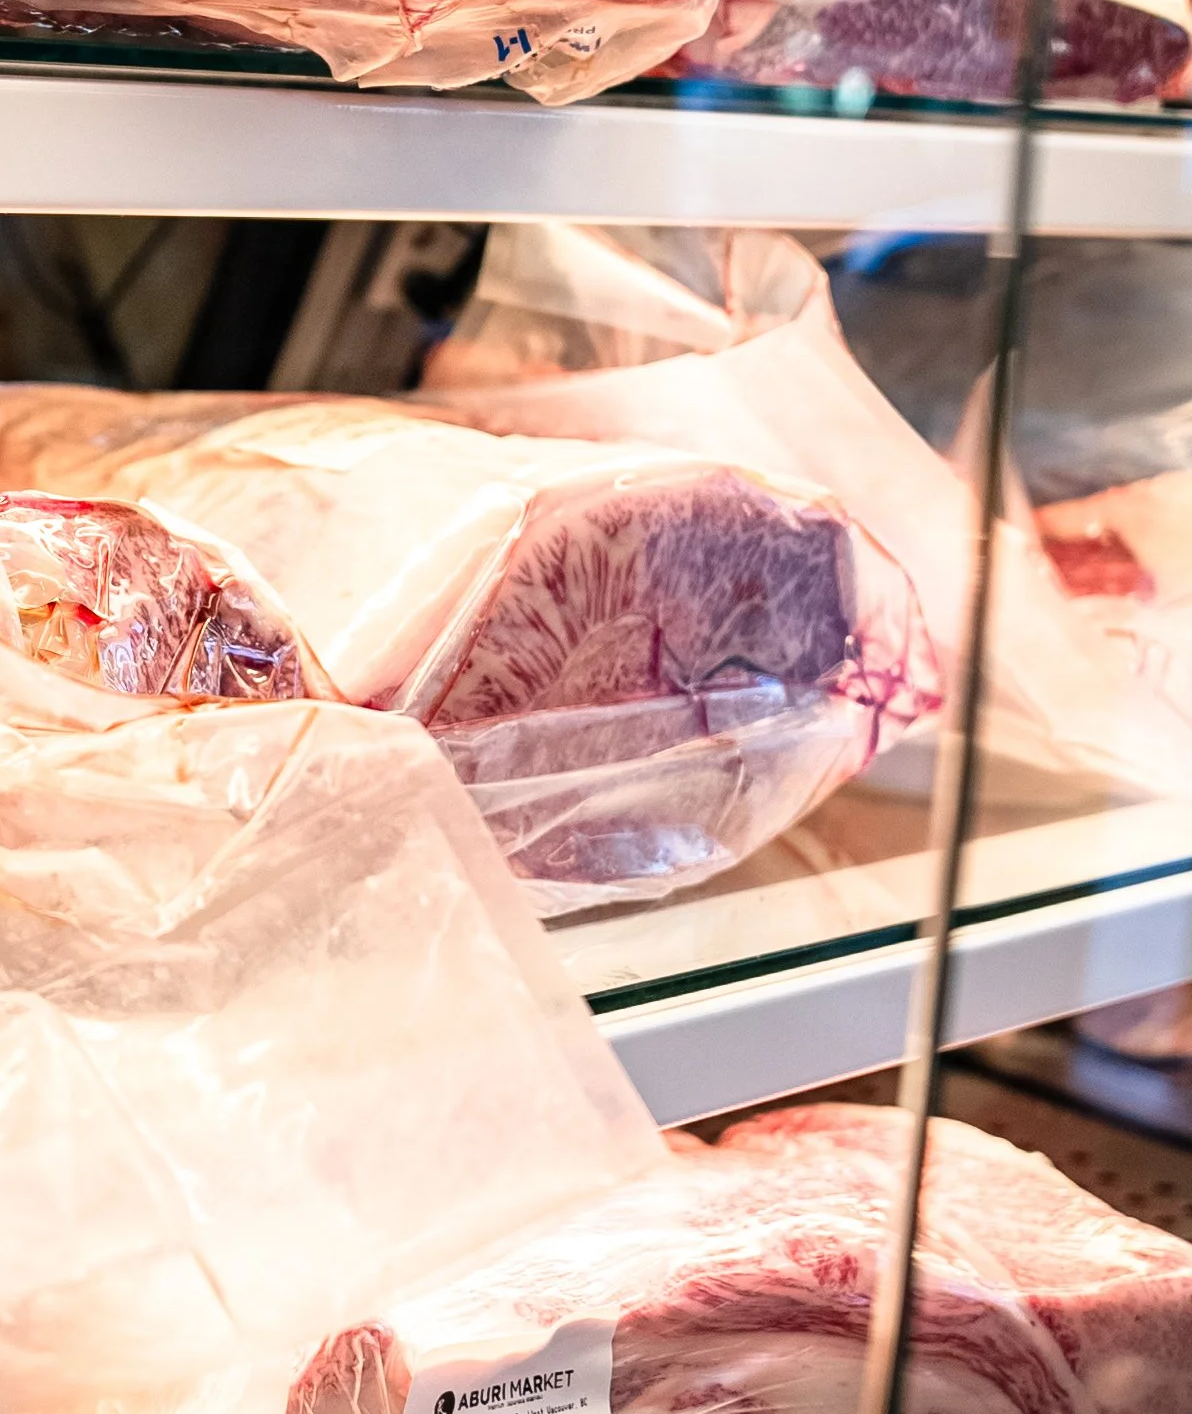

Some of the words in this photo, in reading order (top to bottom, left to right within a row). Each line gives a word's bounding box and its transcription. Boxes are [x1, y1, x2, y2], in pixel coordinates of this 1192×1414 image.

[457, 1382, 506, 1411] ABURI
[510, 1369, 575, 1399] MARKET
[580, 1396, 588, 1408] BC
